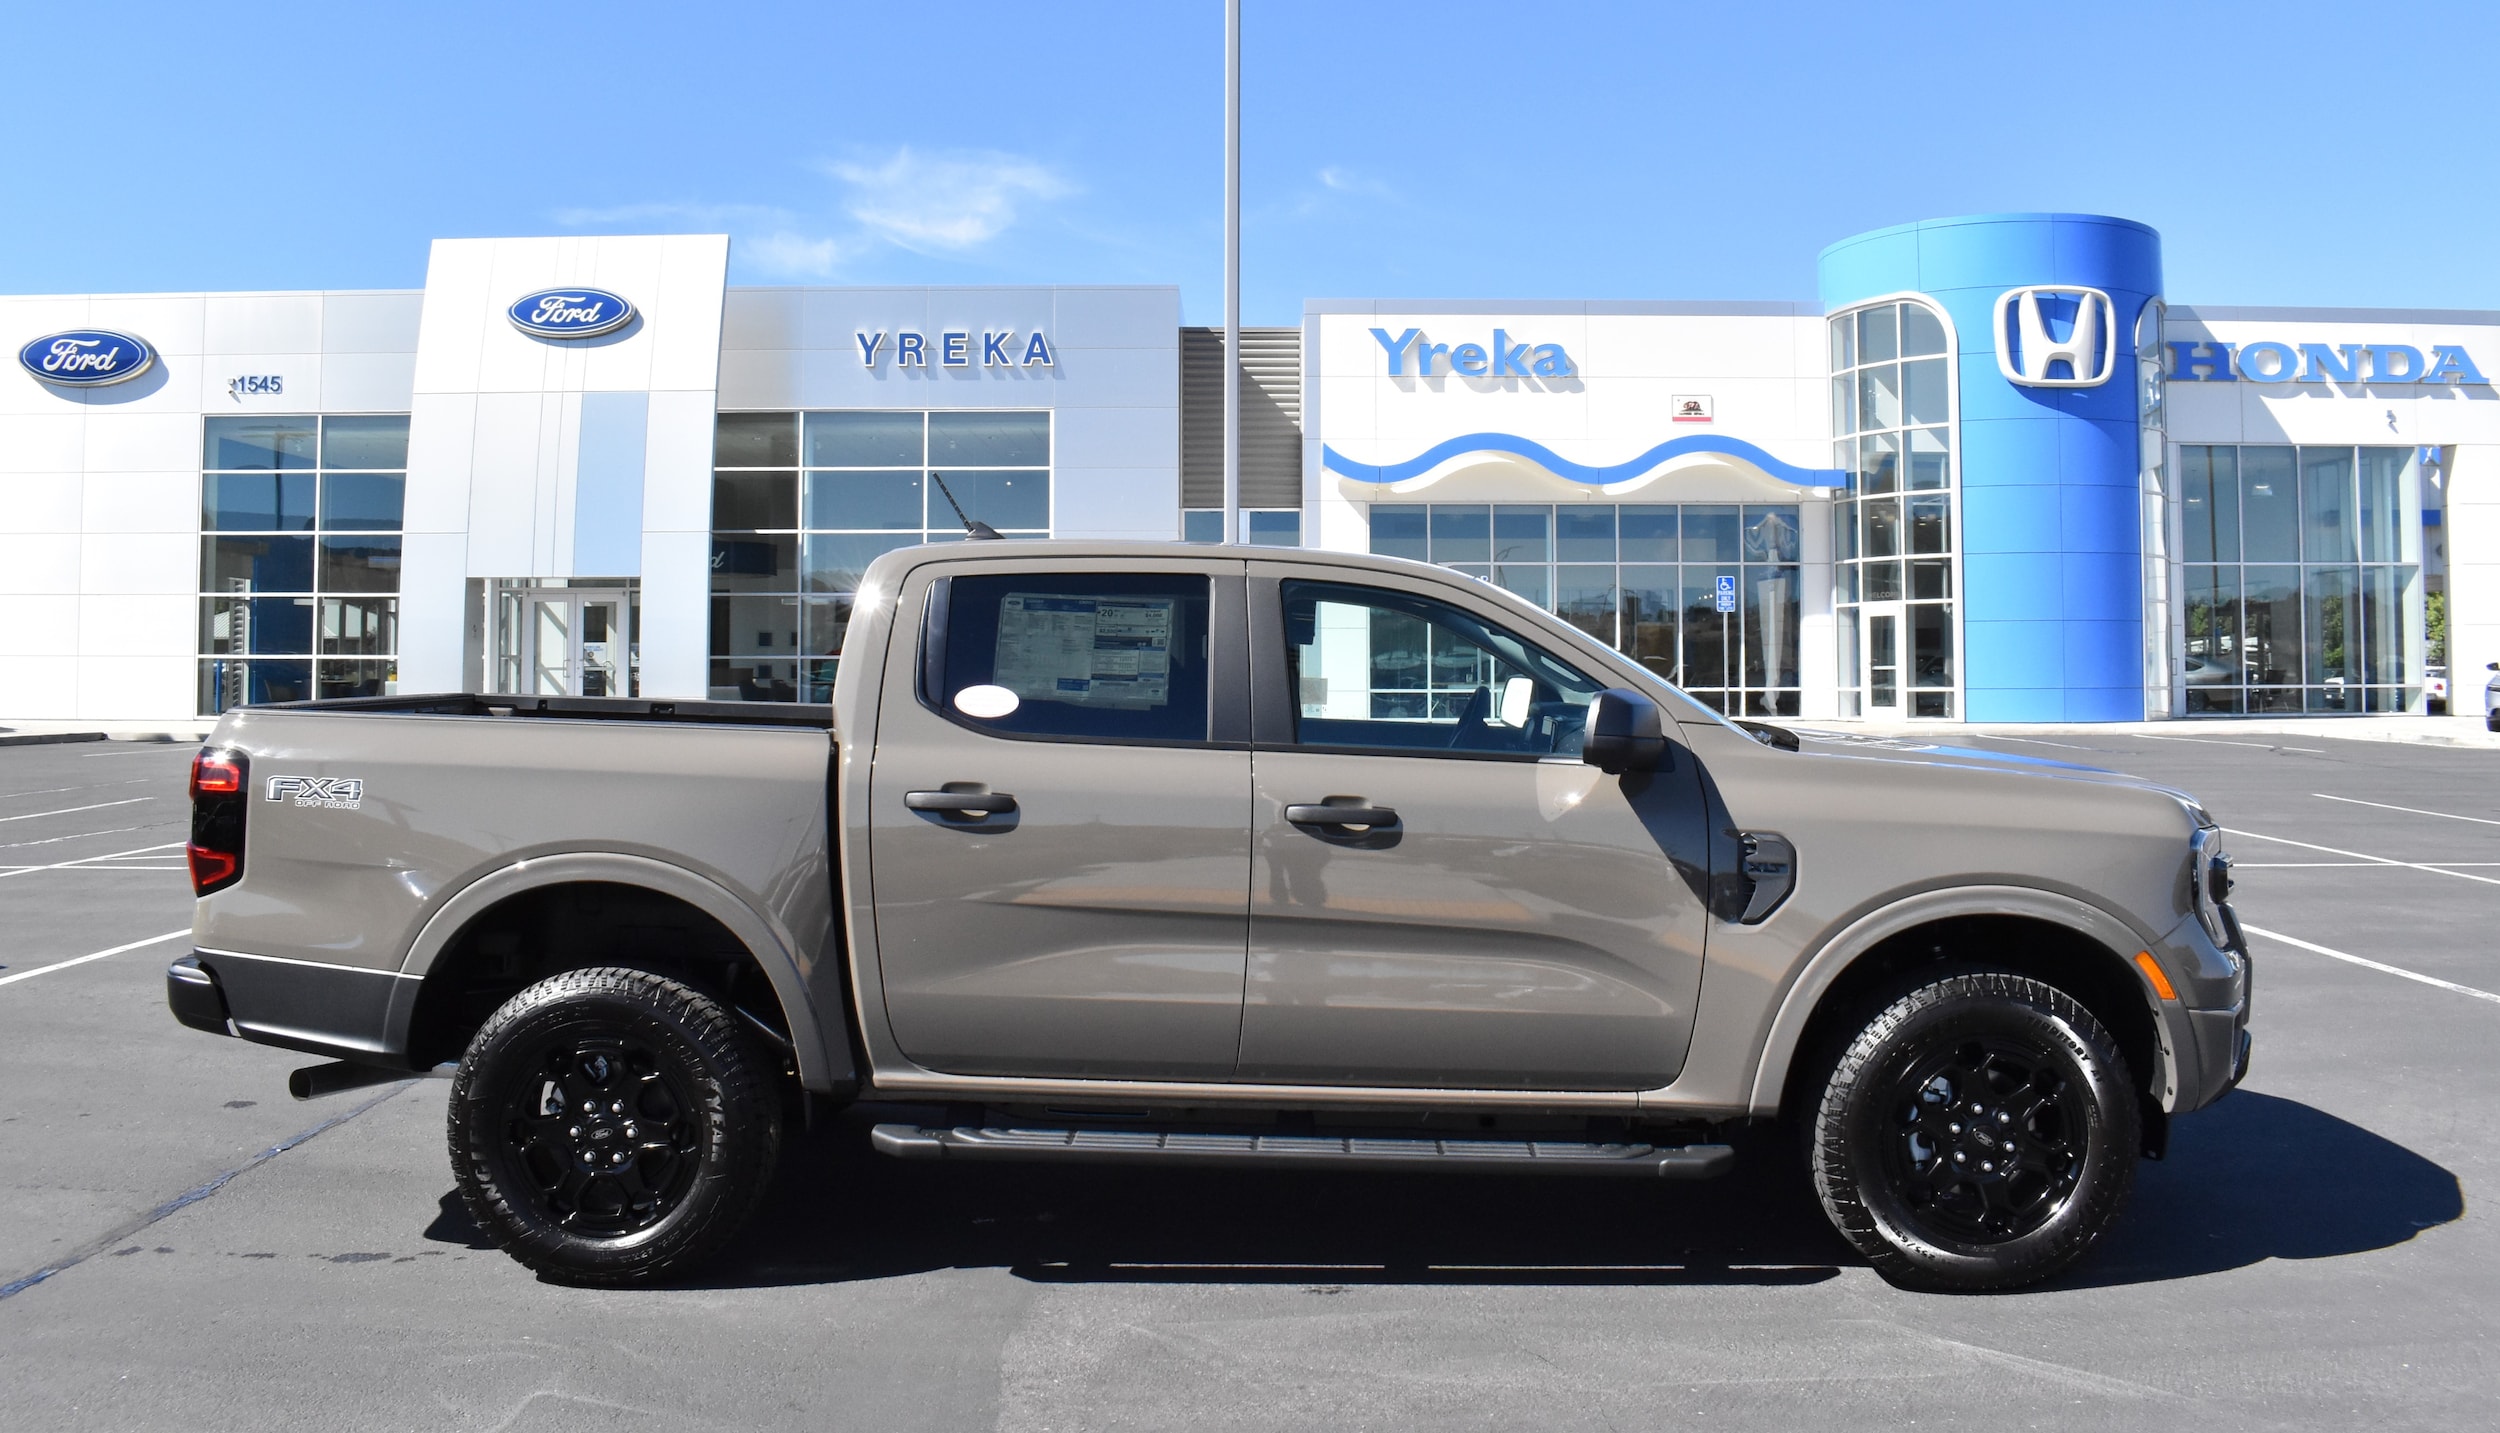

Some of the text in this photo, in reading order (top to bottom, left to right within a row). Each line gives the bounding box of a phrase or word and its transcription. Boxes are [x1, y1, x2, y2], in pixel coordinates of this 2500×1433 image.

[531, 296, 603, 324] Ford
[43, 339, 119, 371] Ford
[855, 330, 1054, 367] YREKA
[1368, 328, 1572, 377] Yreka
[2166, 341, 2490, 384] HONDA
[238, 375, 283, 394] 1545
[266, 775, 363, 802] FX4
[295, 800, 360, 809] OFF ROAD
